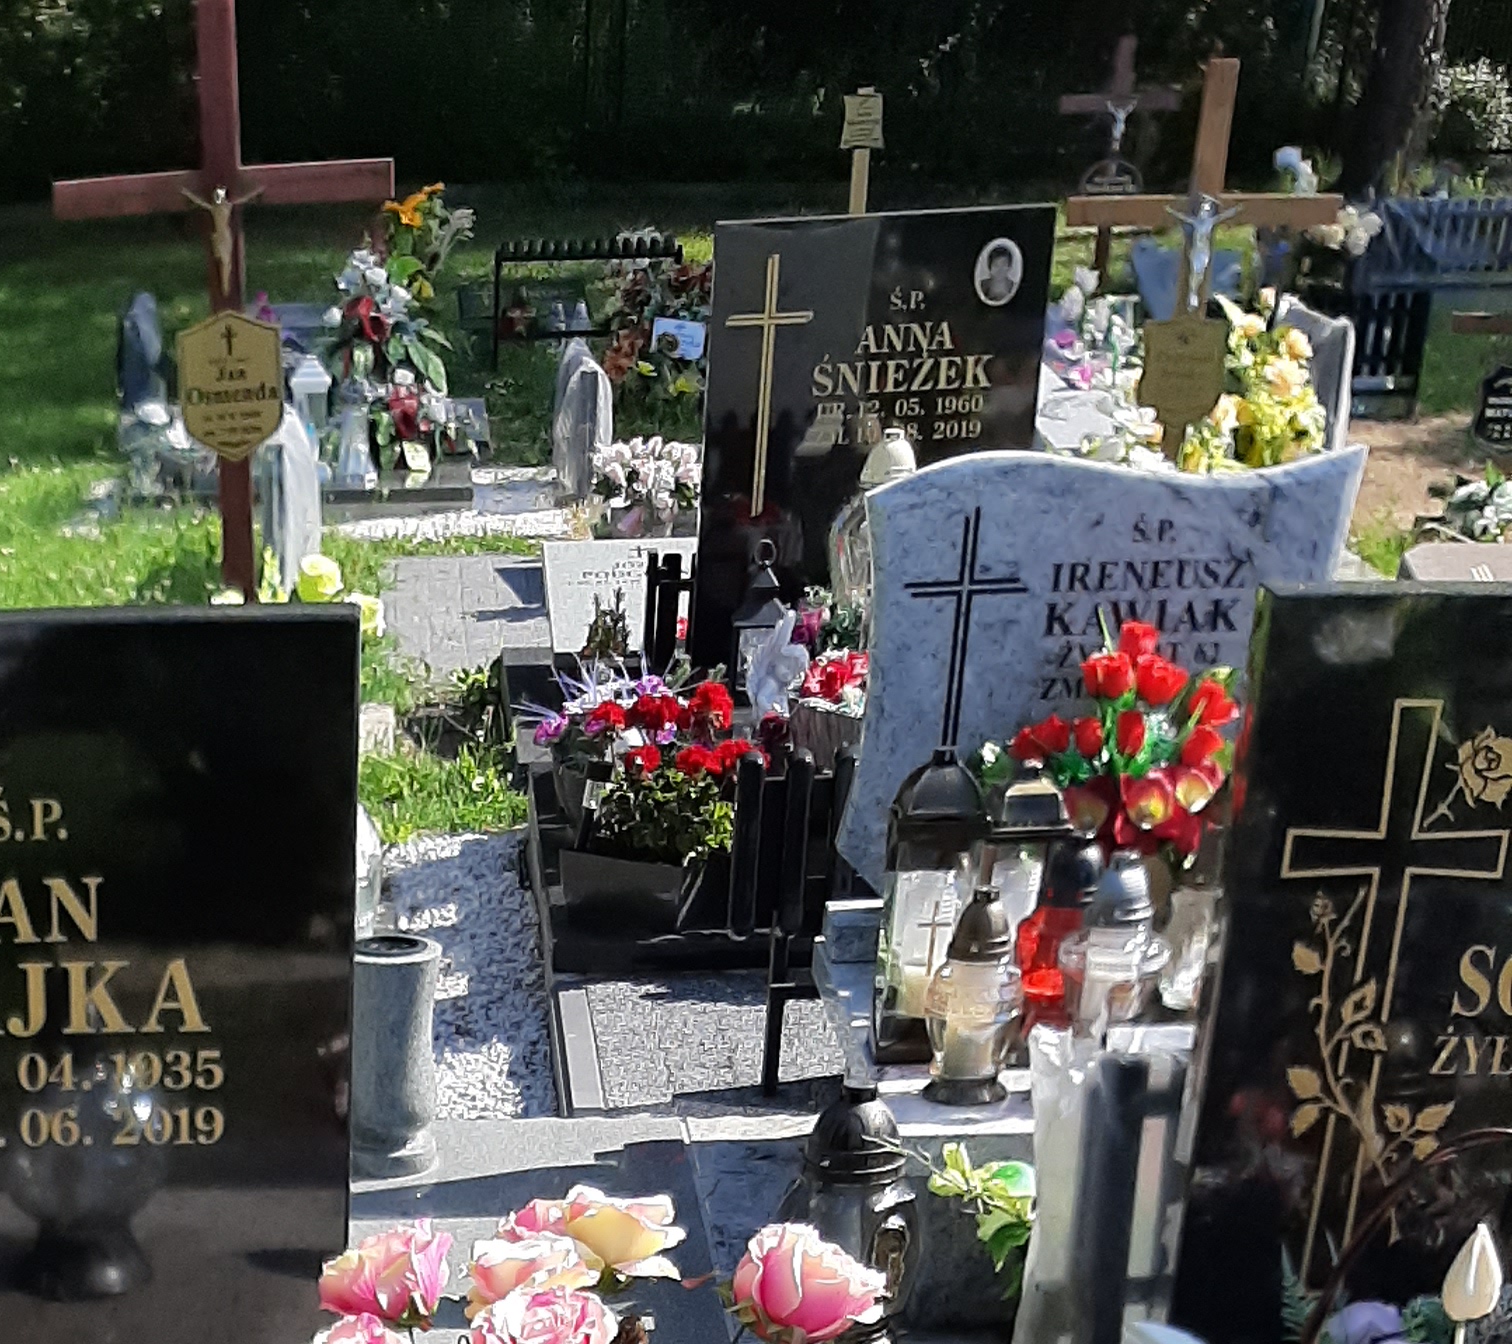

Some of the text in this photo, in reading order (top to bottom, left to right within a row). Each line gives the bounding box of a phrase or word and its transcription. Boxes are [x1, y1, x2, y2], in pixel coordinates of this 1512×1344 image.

[855, 321, 955, 354] ANNA
[812, 353, 994, 397] ŚNIEŻEK
[895, 398, 926, 417] 05.
[935, 395, 984, 415] 1960
[932, 420, 982, 440] 2019
[1051, 558, 1246, 593] IRENEUSZ
[1043, 600, 1239, 637] KAWIAK
[16, 1051, 94, 1093] 04.
[110, 1049, 226, 1092] 1935
[19, 1107, 94, 1147] 06.
[112, 1105, 226, 1148] 2019
